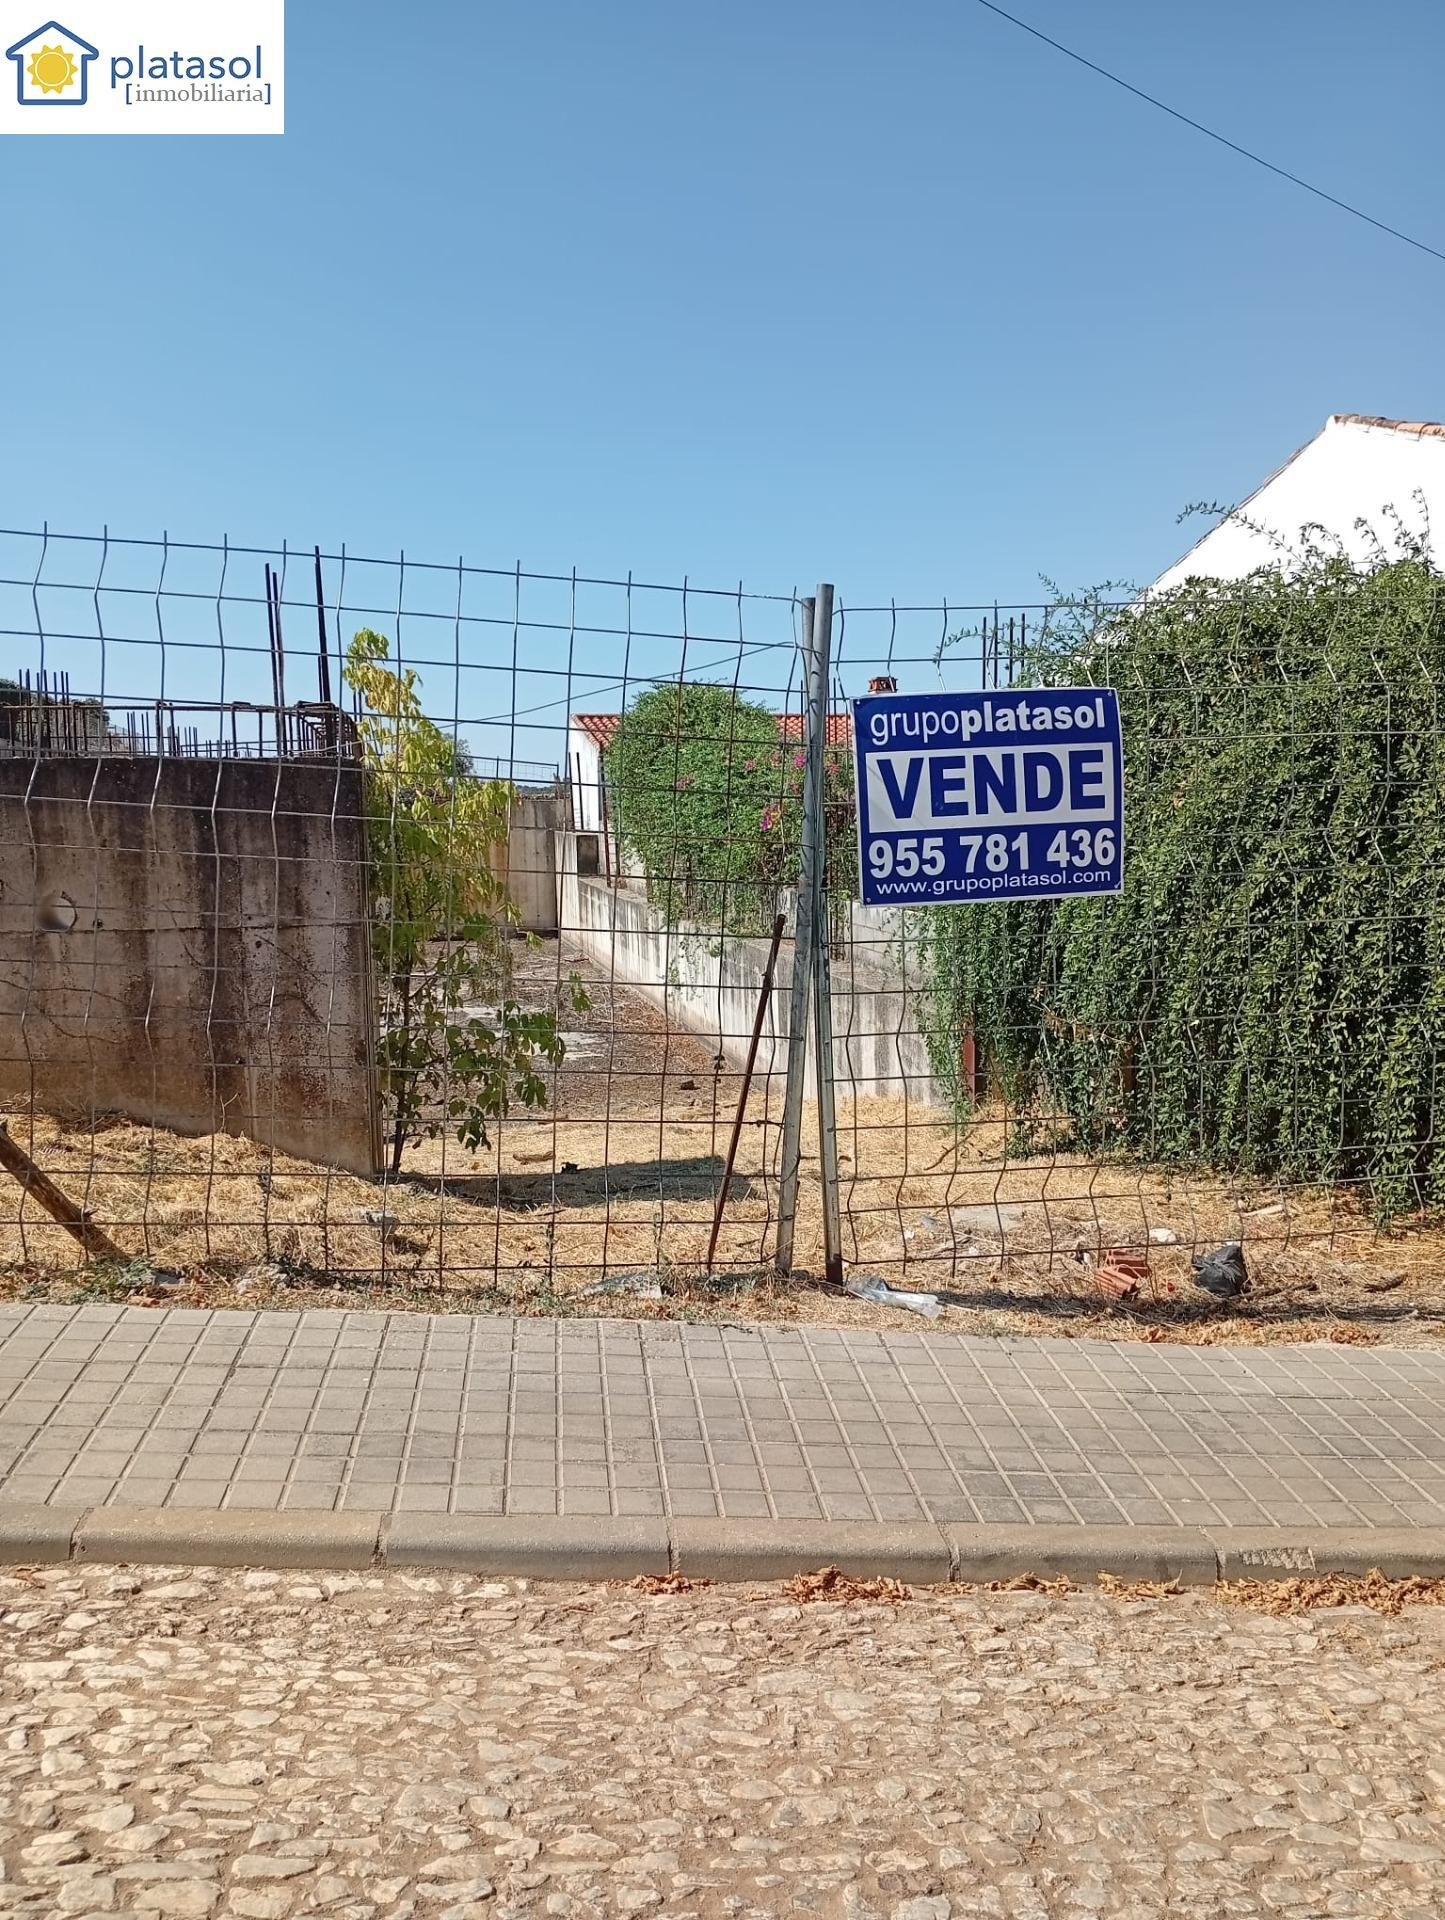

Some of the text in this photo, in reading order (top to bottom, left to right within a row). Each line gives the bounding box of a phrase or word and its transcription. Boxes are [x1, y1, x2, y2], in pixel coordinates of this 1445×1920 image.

[870, 697, 1105, 746] grupoplatasol
[876, 749, 1106, 820] VENDE
[868, 827, 1115, 879] 955 781 436
[876, 870, 1111, 895] www.grupoplatasol.com
